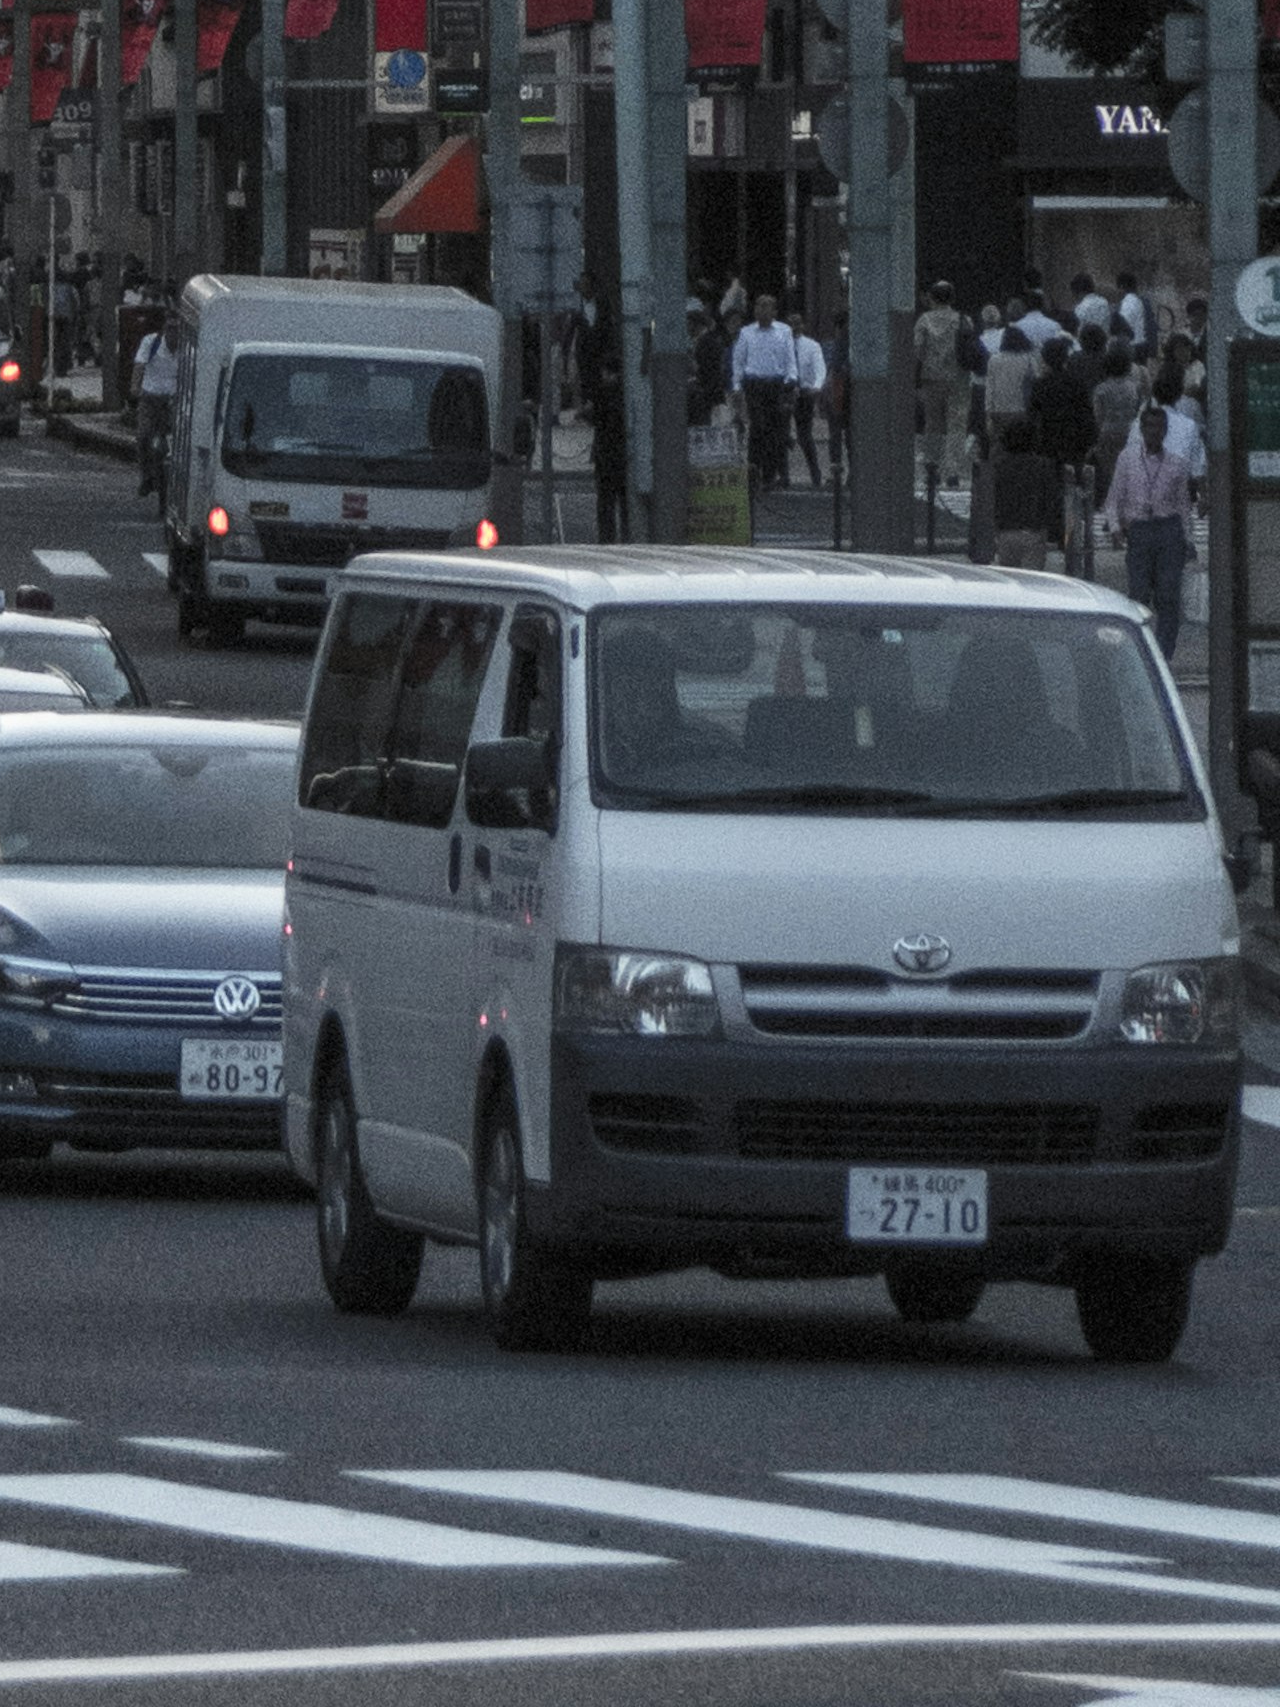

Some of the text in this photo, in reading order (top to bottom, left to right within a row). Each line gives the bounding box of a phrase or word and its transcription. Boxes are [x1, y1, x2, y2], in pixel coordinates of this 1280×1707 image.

[207, 1062, 284, 1093] 80-97
[925, 1174, 957, 1194] 400
[880, 1198, 979, 1233] 27-10
